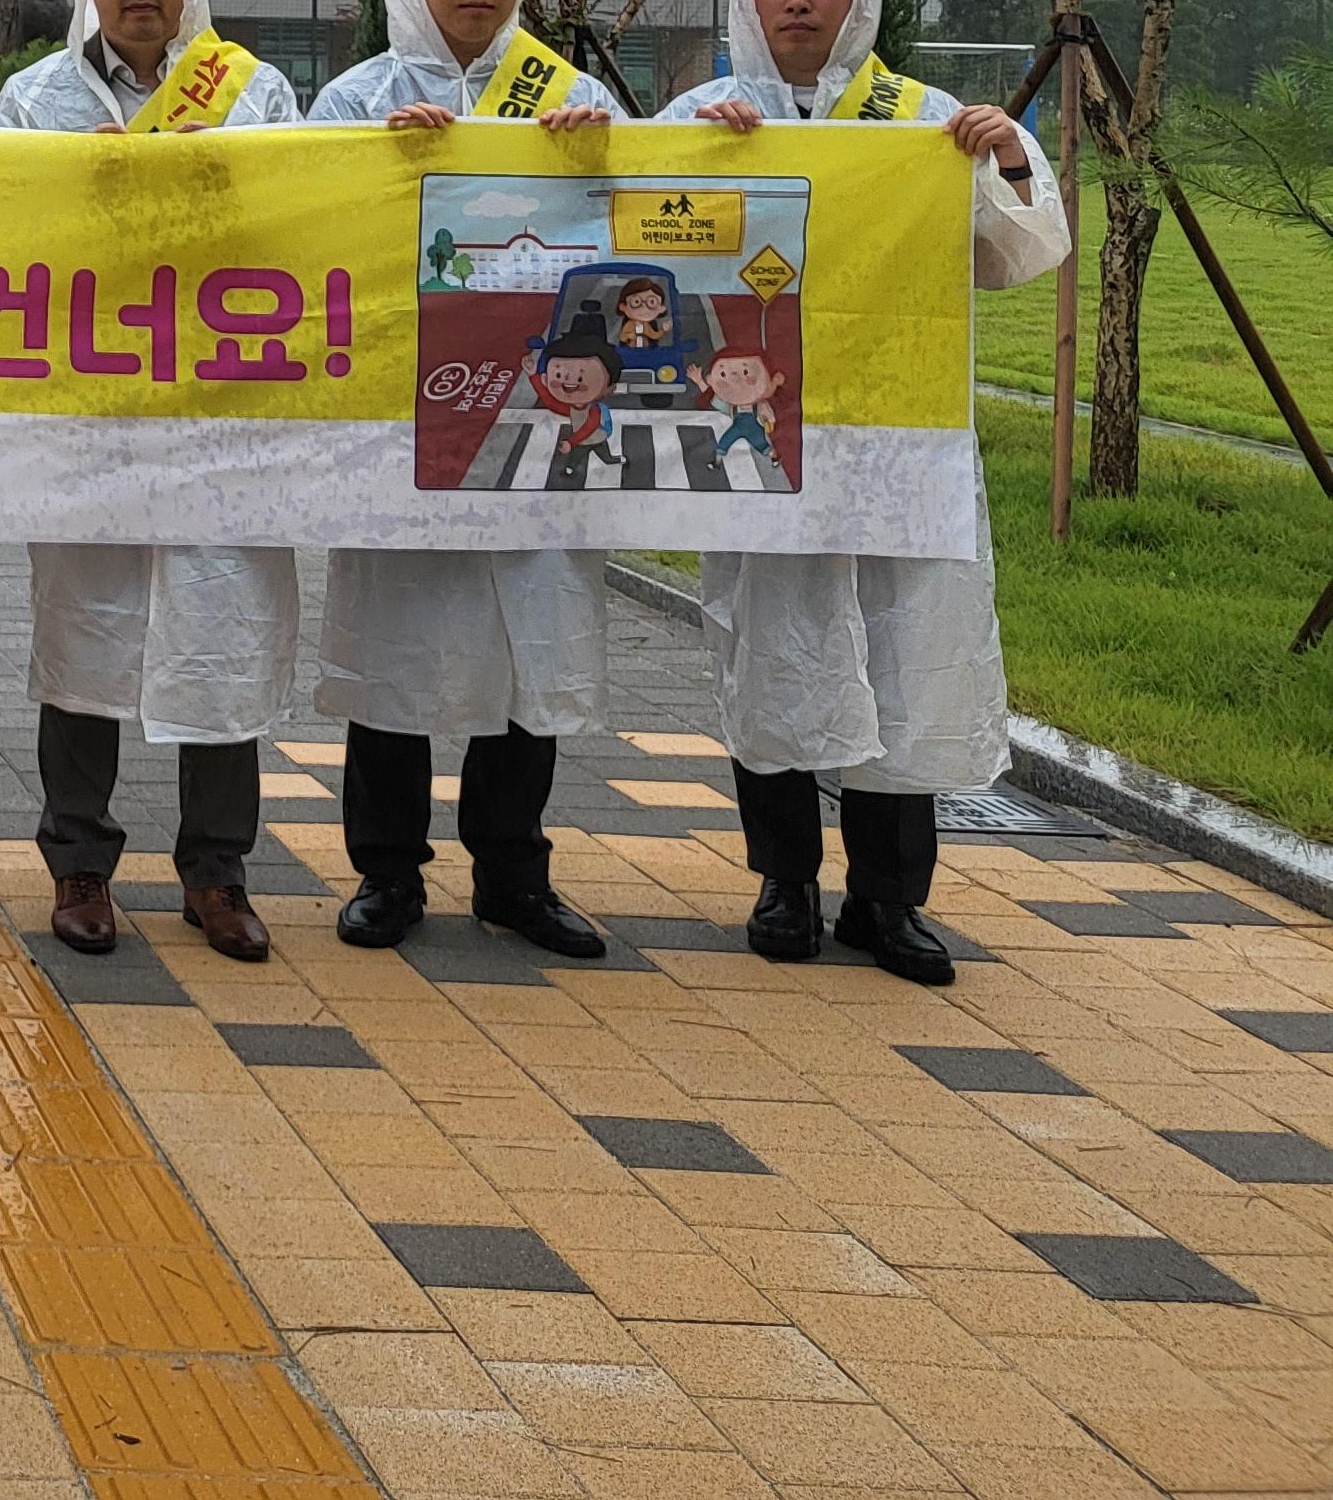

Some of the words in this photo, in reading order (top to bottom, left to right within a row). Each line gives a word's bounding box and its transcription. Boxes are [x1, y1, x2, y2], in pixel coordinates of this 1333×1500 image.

[497, 55, 558, 119] 어린이
[640, 218, 683, 229] SCHOOL
[688, 218, 716, 229] ZONE
[641, 231, 716, 245] 어린이보호구역
[749, 265, 788, 276] SCHOOL
